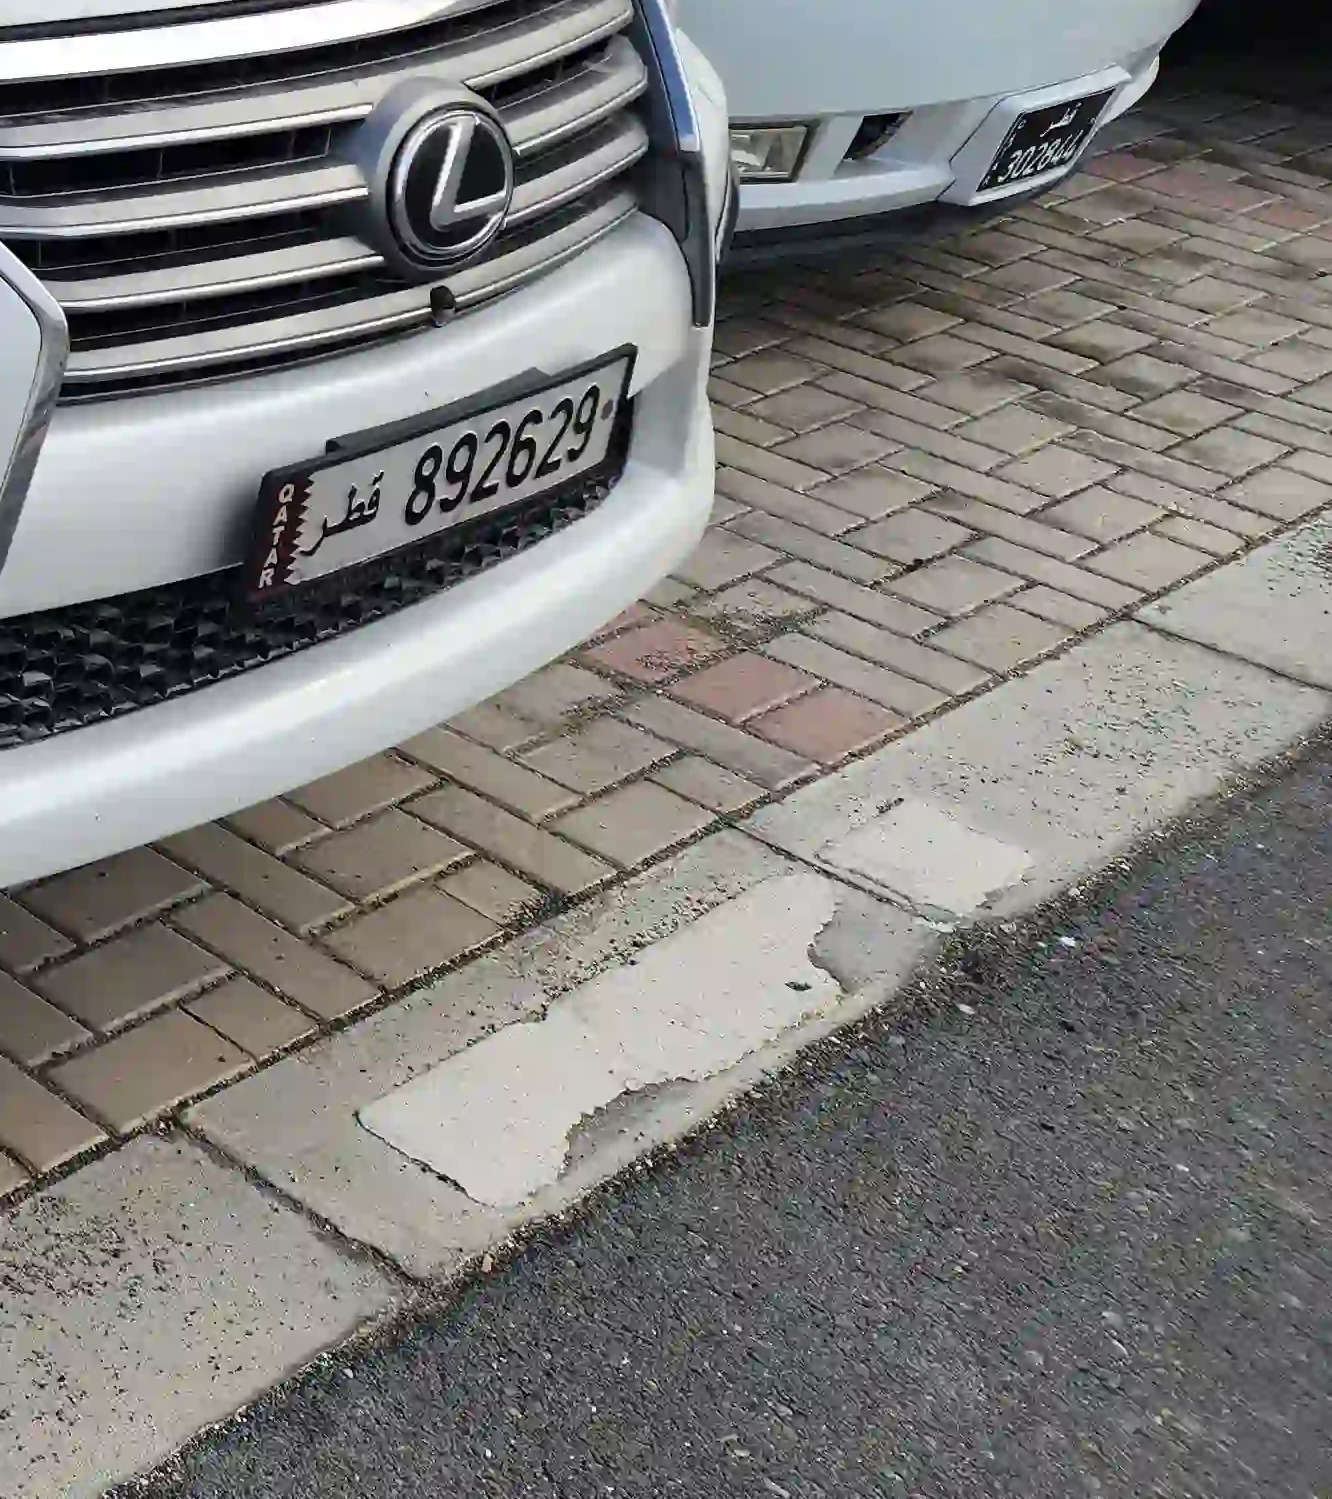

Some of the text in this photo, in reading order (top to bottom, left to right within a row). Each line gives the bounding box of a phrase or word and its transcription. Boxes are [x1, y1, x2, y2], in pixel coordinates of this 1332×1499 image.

[258, 483, 296, 590] QATAR
[299, 383, 601, 557] قطر 892629
